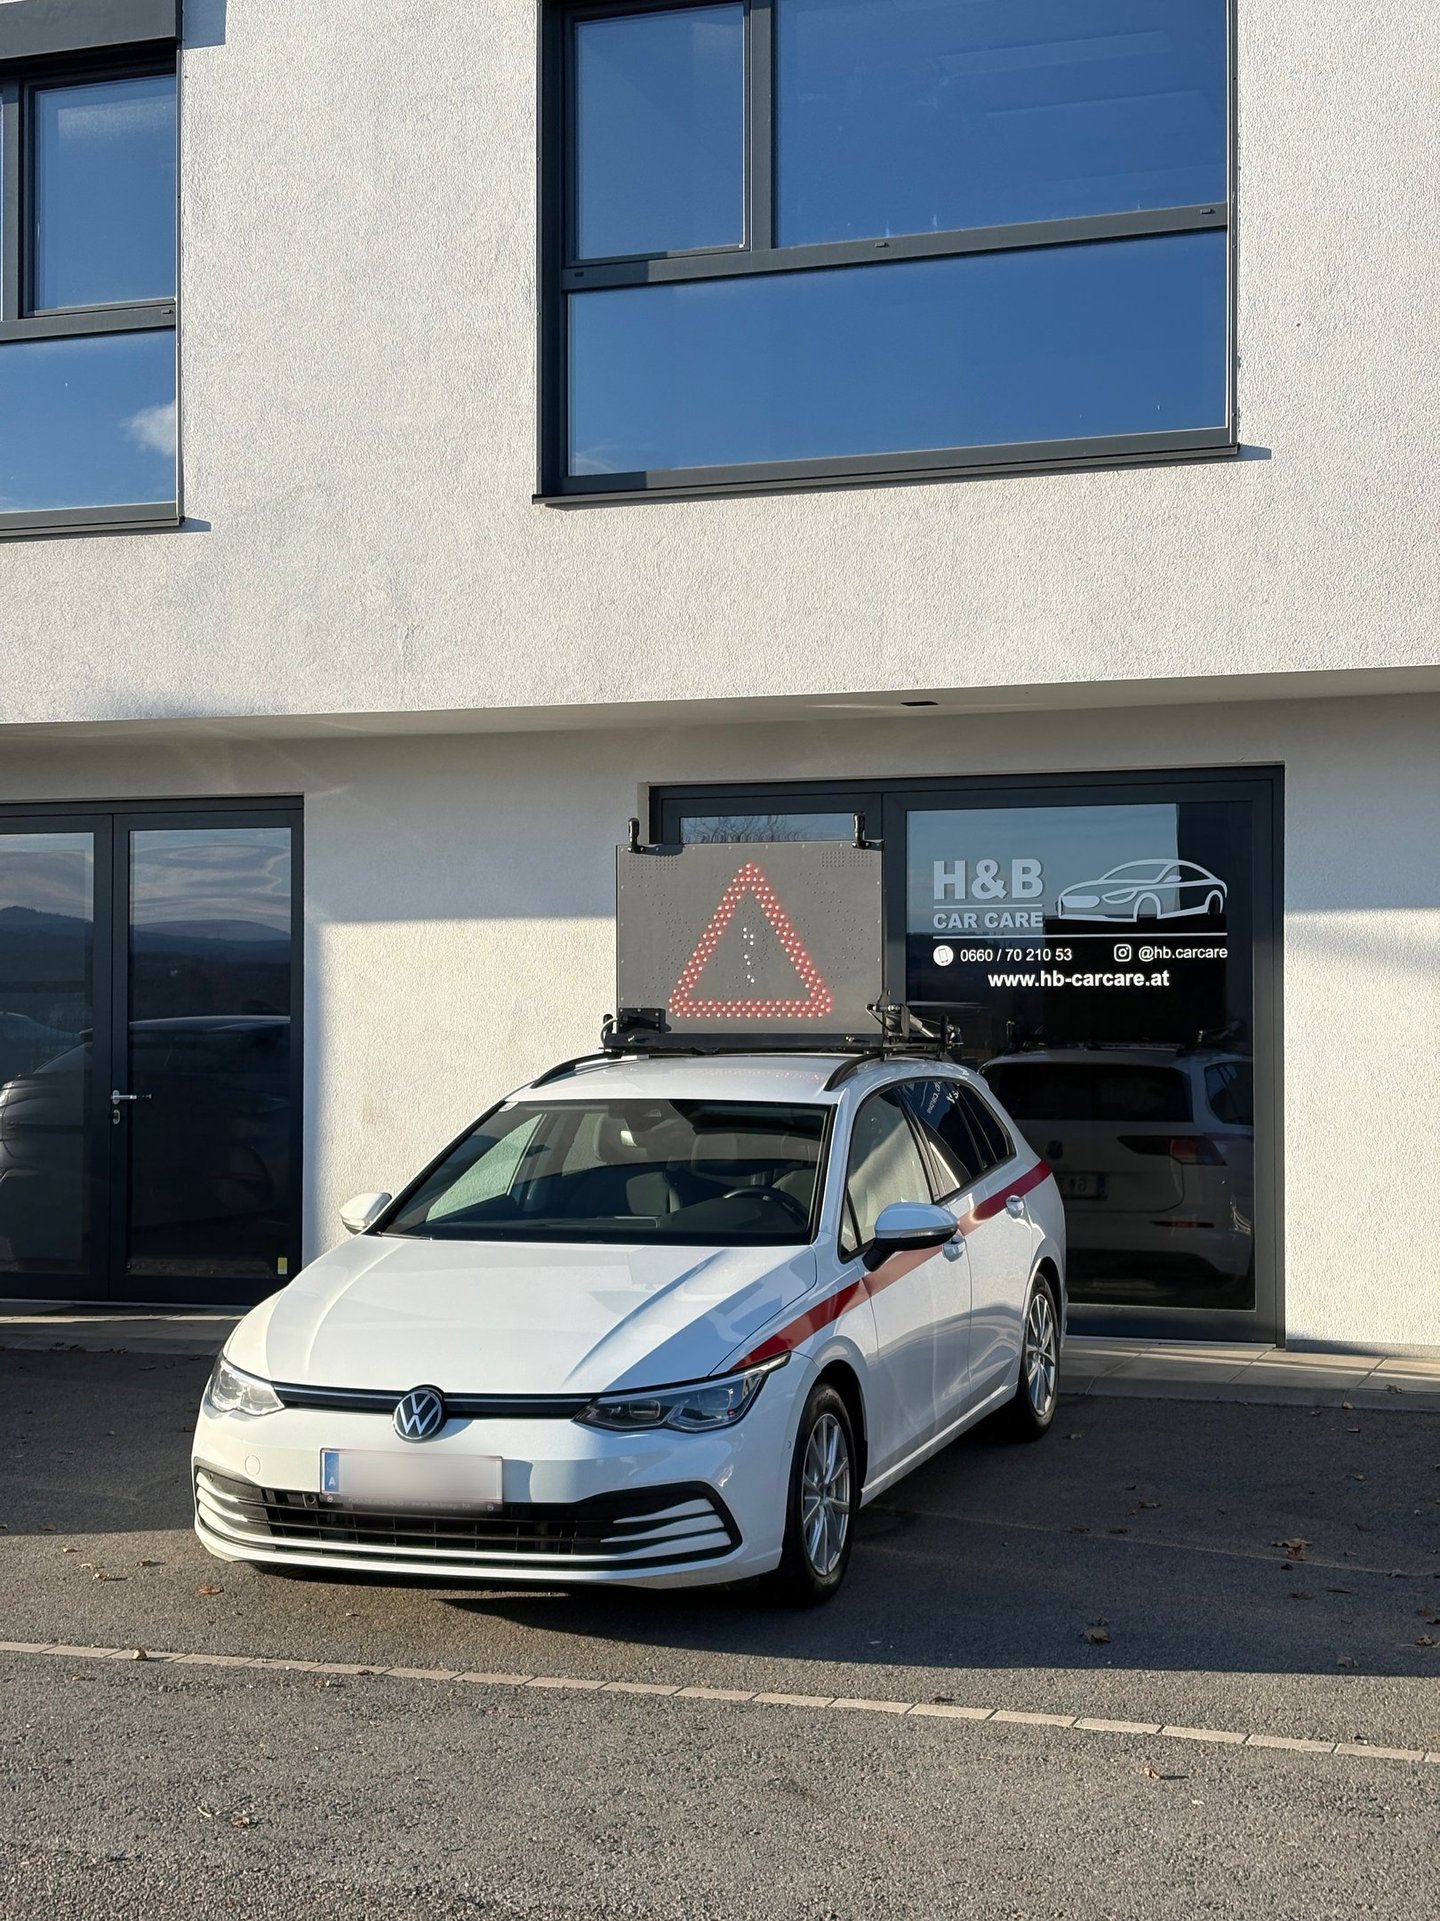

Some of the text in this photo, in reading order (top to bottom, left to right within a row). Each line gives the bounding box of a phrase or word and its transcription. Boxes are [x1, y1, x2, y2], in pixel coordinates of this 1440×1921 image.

[933, 858, 1044, 899] H&B
[933, 912, 1044, 928] CAR CARE
[960, 949, 993, 962] 0660
[1006, 949, 1022, 962] 70
[1026, 948, 1051, 961] 210
[1055, 948, 1073, 961] 53
[1138, 945, 1229, 961] @hb.carcare
[988, 970, 1170, 987] www.hb-carcare.at
[397, 1391, 440, 1437] VW
[328, 1476, 336, 1487] A
